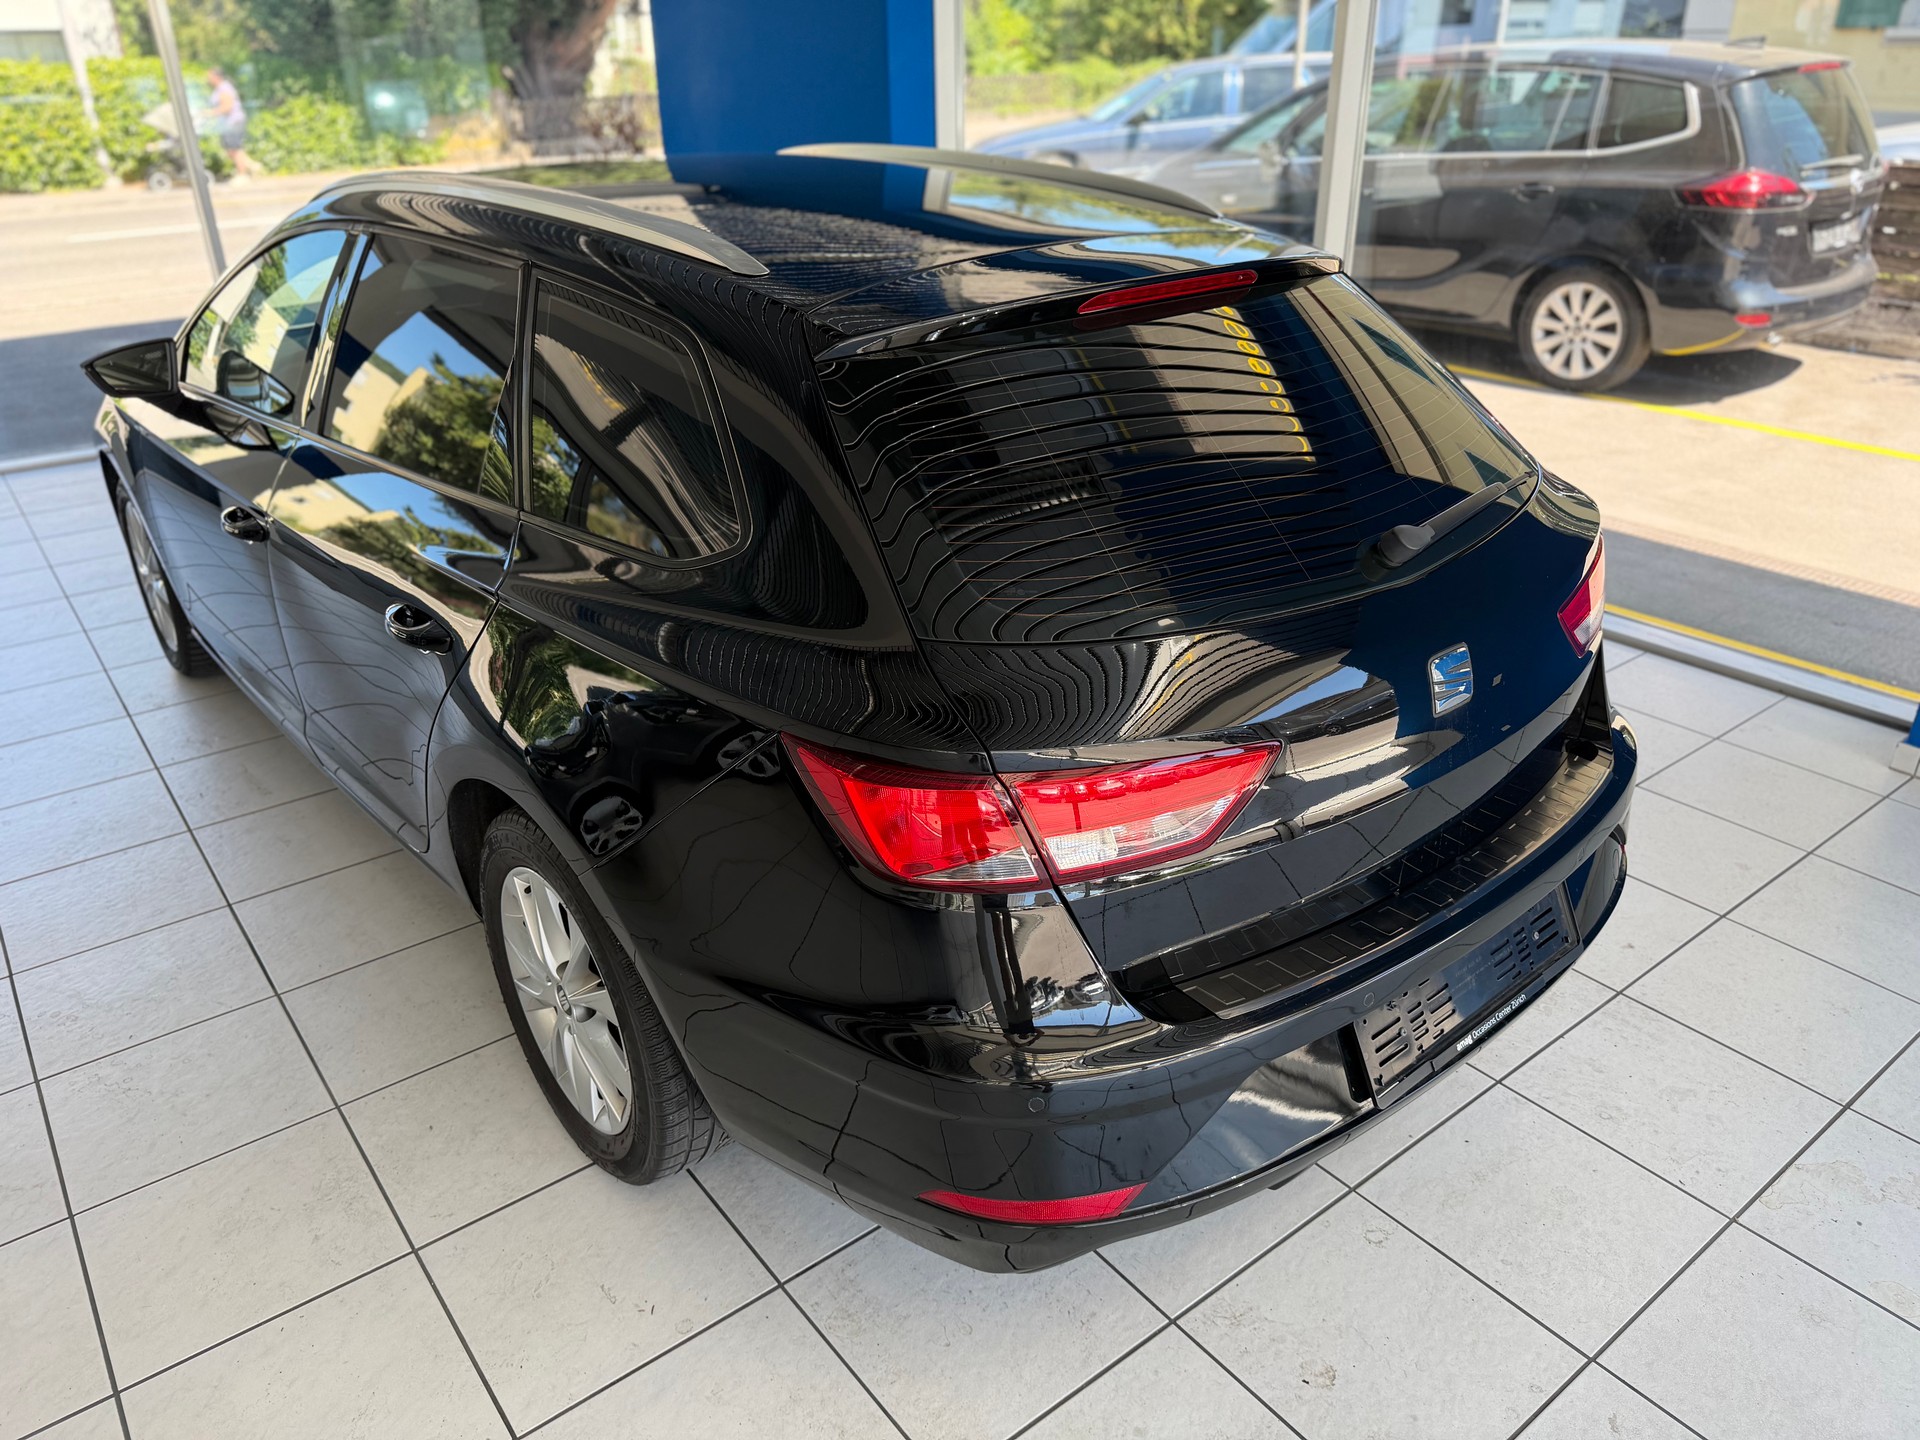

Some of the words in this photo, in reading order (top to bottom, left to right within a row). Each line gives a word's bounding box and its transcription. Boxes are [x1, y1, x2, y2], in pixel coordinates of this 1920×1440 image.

[1456, 1034, 1473, 1051] amag
[1472, 1017, 1496, 1039] Occasions
[1495, 1004, 1512, 1021] Center
[1511, 994, 1527, 1009] Zürich
